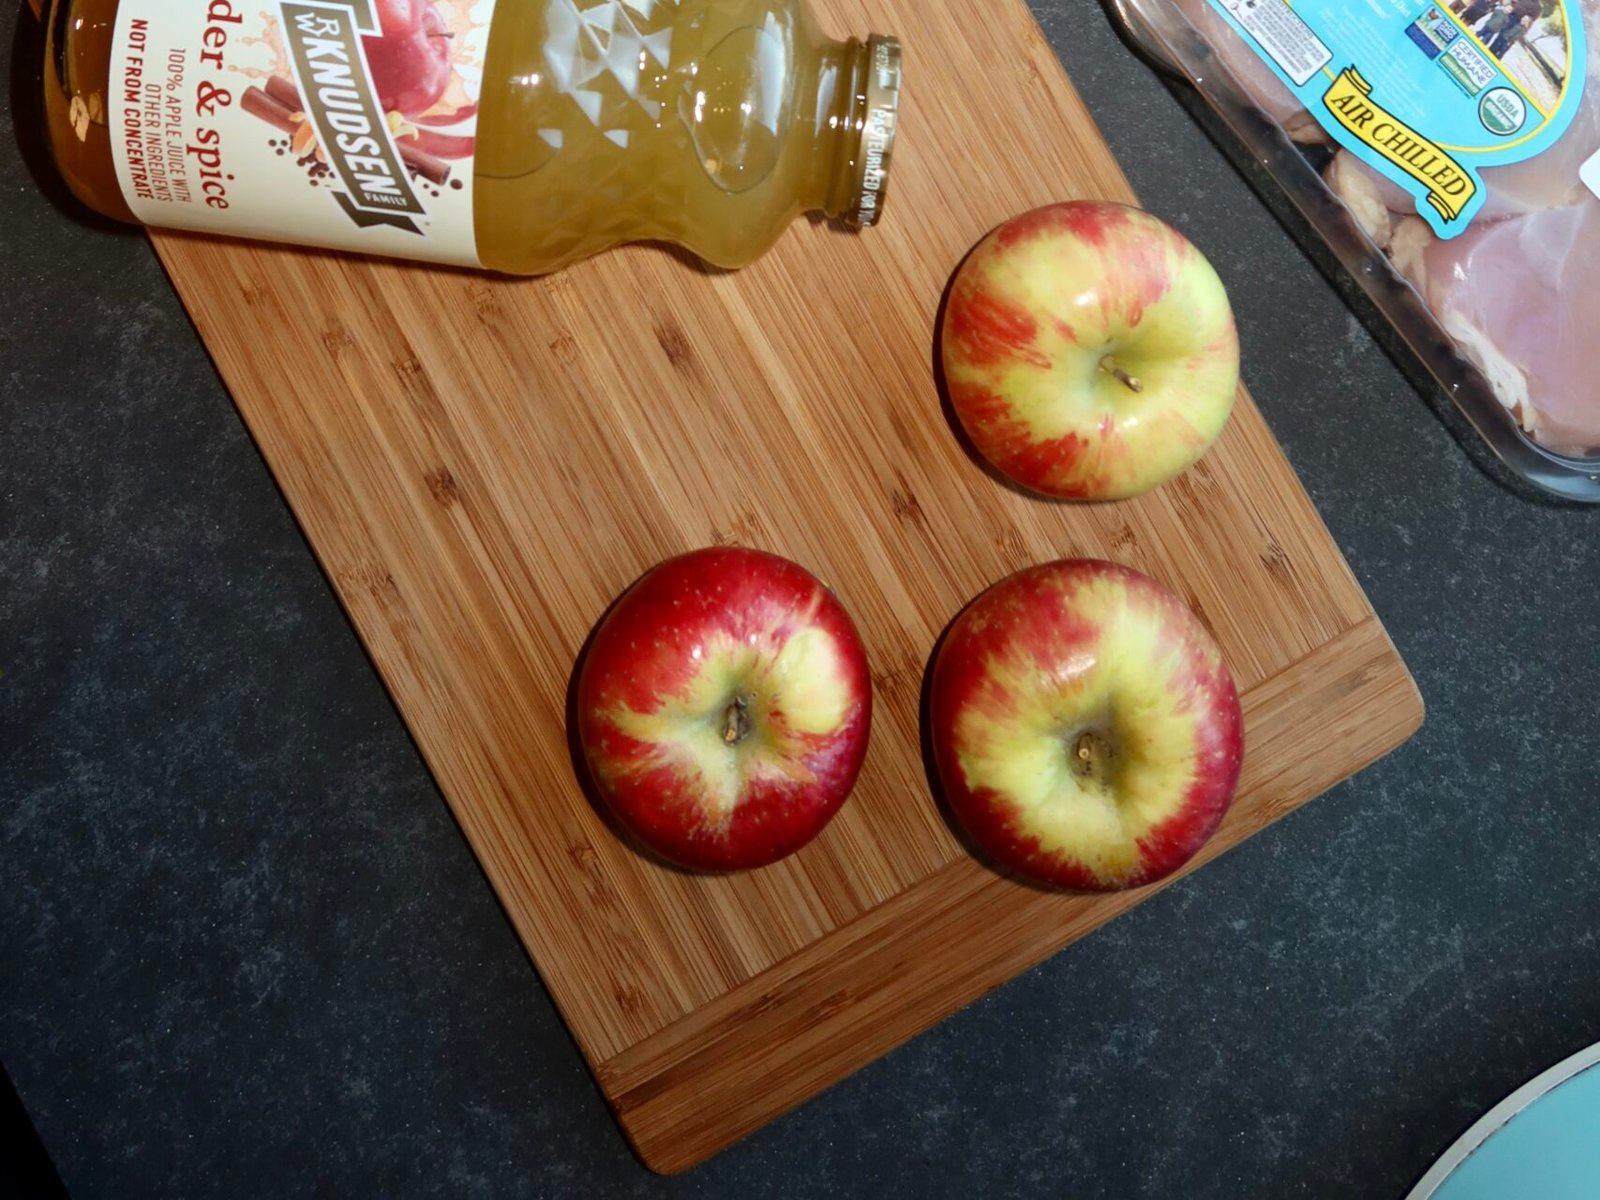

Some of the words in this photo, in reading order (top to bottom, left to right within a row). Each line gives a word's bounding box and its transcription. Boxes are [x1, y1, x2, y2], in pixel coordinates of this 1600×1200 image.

[127, 19, 147, 52] NOT
[125, 57, 142, 102] FROM
[167, 49, 185, 90] 100%
[1452, 49, 1486, 83] HUMANE
[1458, 41, 1493, 78] CERTIFIED
[145, 84, 160, 127] OTHER
[166, 96, 181, 137] APPLE
[196, 81, 231, 118] &
[303, 38, 401, 194] KNUDSEN
[1496, 94, 1519, 118] USDA
[124, 109, 153, 199] CONCENTRATE
[166, 142, 185, 175] JUICE
[863, 109, 887, 188] PASTEURIZED
[1332, 96, 1375, 129] AIR
[1373, 123, 1467, 195] CHILLED
[146, 133, 172, 201] INGREDIENTS
[186, 128, 234, 209] spice
[173, 180, 191, 202] WITH
[365, 193, 407, 206] FAMILY
